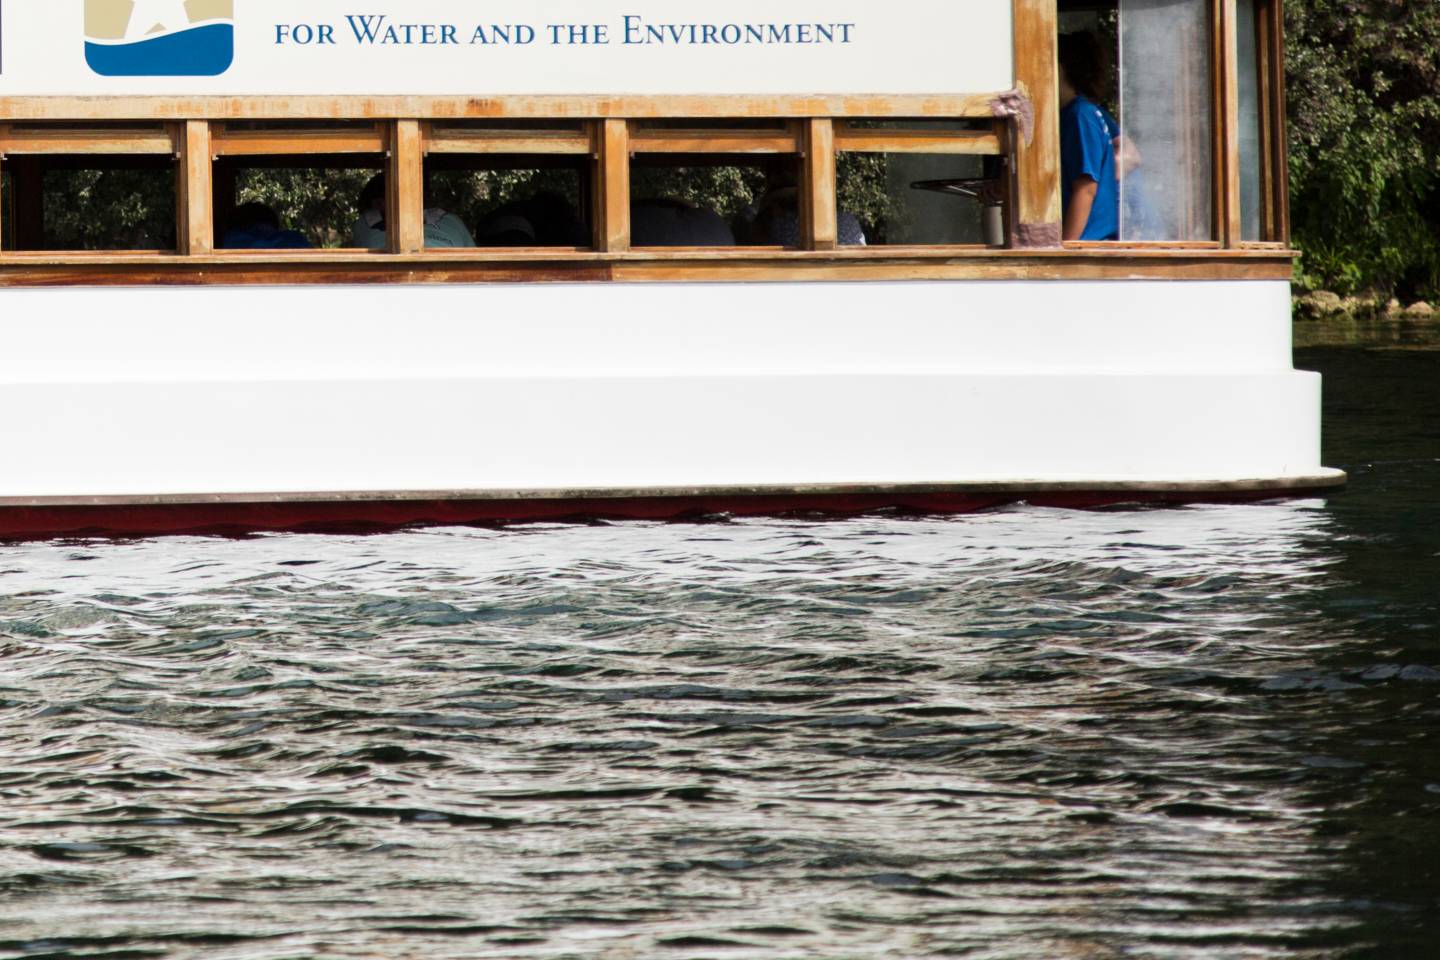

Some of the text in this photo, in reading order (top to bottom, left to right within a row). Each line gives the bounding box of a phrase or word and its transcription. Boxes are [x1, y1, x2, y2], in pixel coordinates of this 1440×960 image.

[274, 15, 855, 45] FOR WATER AND THE ENVIRONMENT
